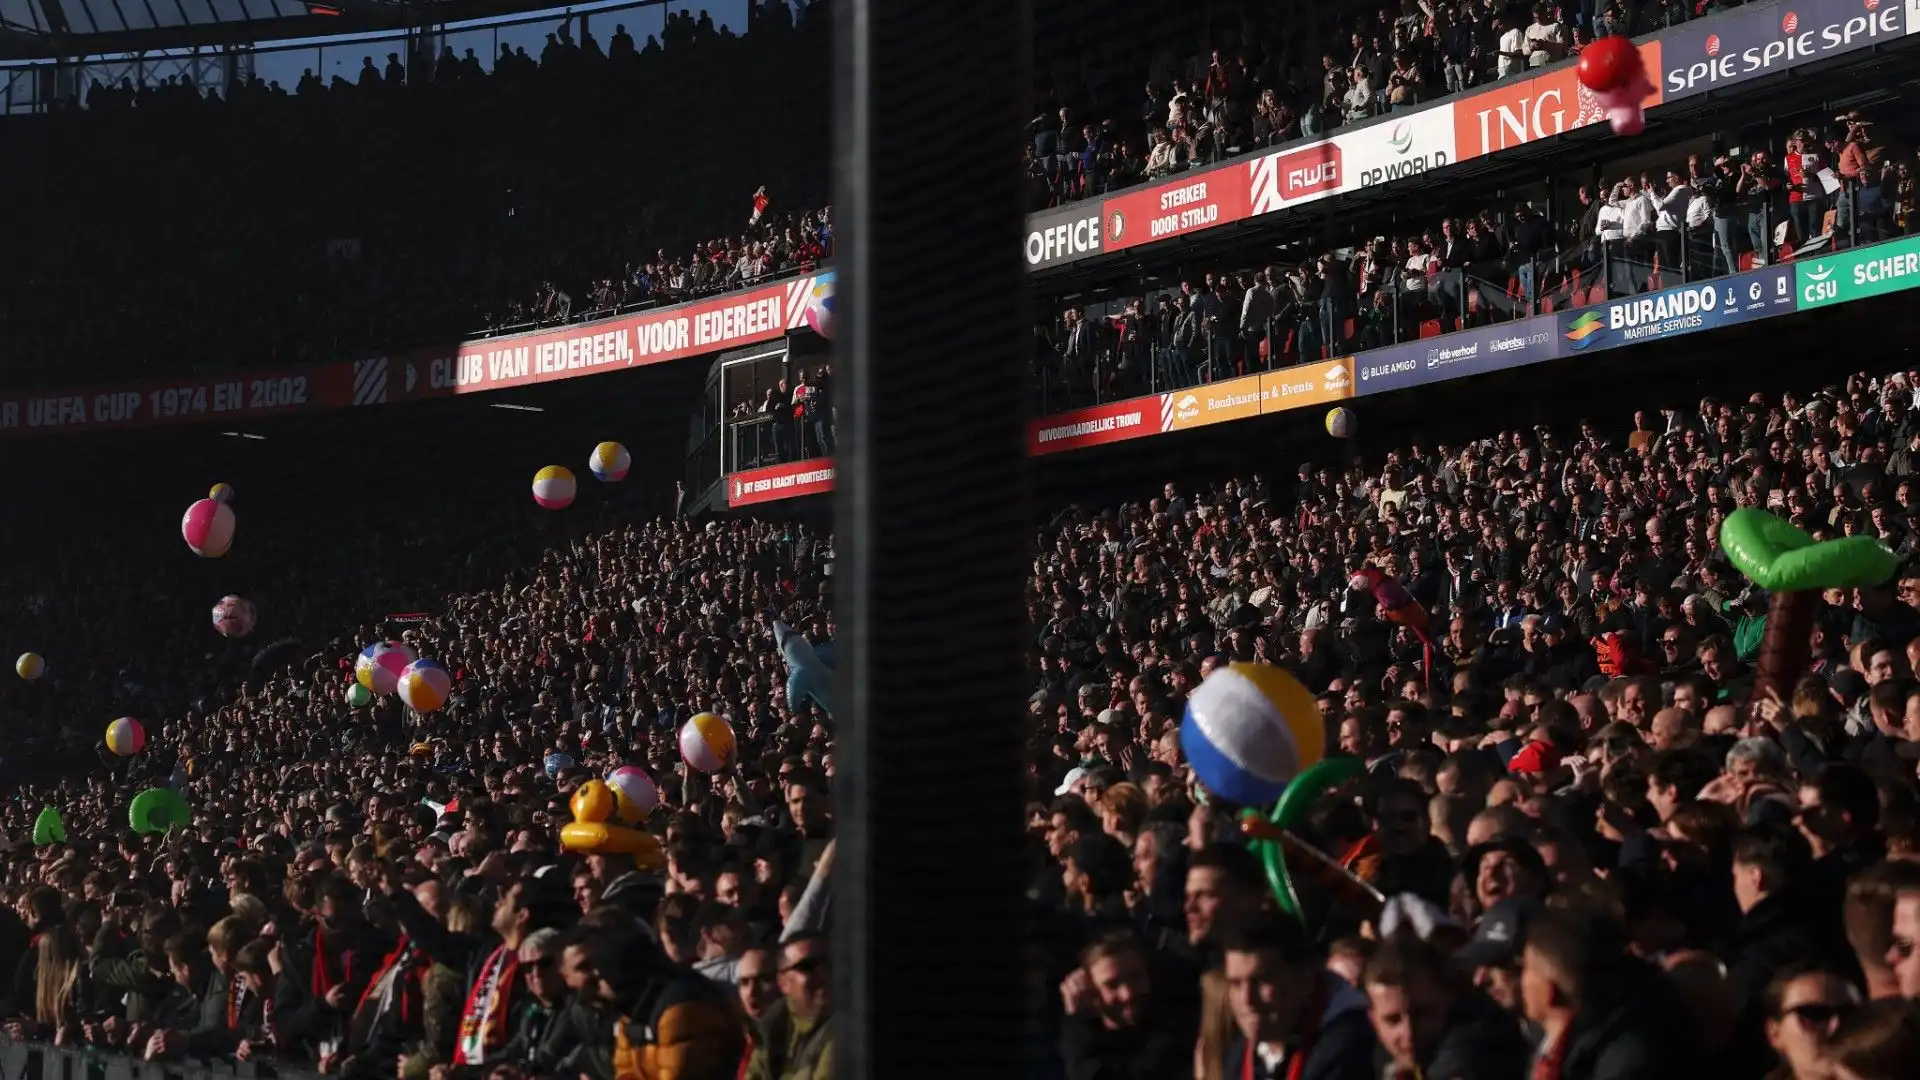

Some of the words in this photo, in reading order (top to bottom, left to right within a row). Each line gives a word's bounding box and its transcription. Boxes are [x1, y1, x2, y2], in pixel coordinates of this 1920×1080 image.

[1668, 53, 1736, 93] SPIE
[1743, 30, 1815, 73] SPIE
[1822, 6, 1899, 50] SPIE
[1477, 88, 1565, 154] ING
[1289, 161, 1336, 191] RWG
[1361, 167, 1383, 188] DP
[1385, 150, 1447, 179] WORLD
[1160, 182, 1207, 210] STERKER
[1151, 213, 1179, 237] DOOR
[1181, 204, 1218, 229] STRIJD
[1026, 216, 1099, 265] OFFICE
[1854, 252, 1920, 285] SCHER
[1610, 286, 1716, 329] BURANDO
[1804, 280, 1837, 302] CSU
[430, 354, 483, 389] CLUB
[488, 346, 529, 381] VAN
[535, 329, 634, 374] IEDEREEN,
[637, 317, 689, 356] VOOR
[694, 296, 781, 346] IEDEREEN
[1624, 322, 1663, 340] MARITIME
[1664, 315, 1702, 332] SERVICES
[1371, 364, 1390, 377] BLUE
[1390, 360, 1416, 373] AMIGO
[0, 401, 19, 428] R
[27, 396, 87, 427] UEFA
[94, 392, 142, 422] CUP
[150, 386, 207, 419] 1974
[213, 381, 244, 411] EN
[250, 375, 308, 408] 2002
[1208, 391, 1269, 411] Rondvaarten
[1271, 385, 1279, 398] &
[1281, 380, 1314, 396] Events
[1115, 412, 1142, 428] TROUW
[754, 478, 771, 492] EIGEN
[772, 475, 796, 489] KRACHT
